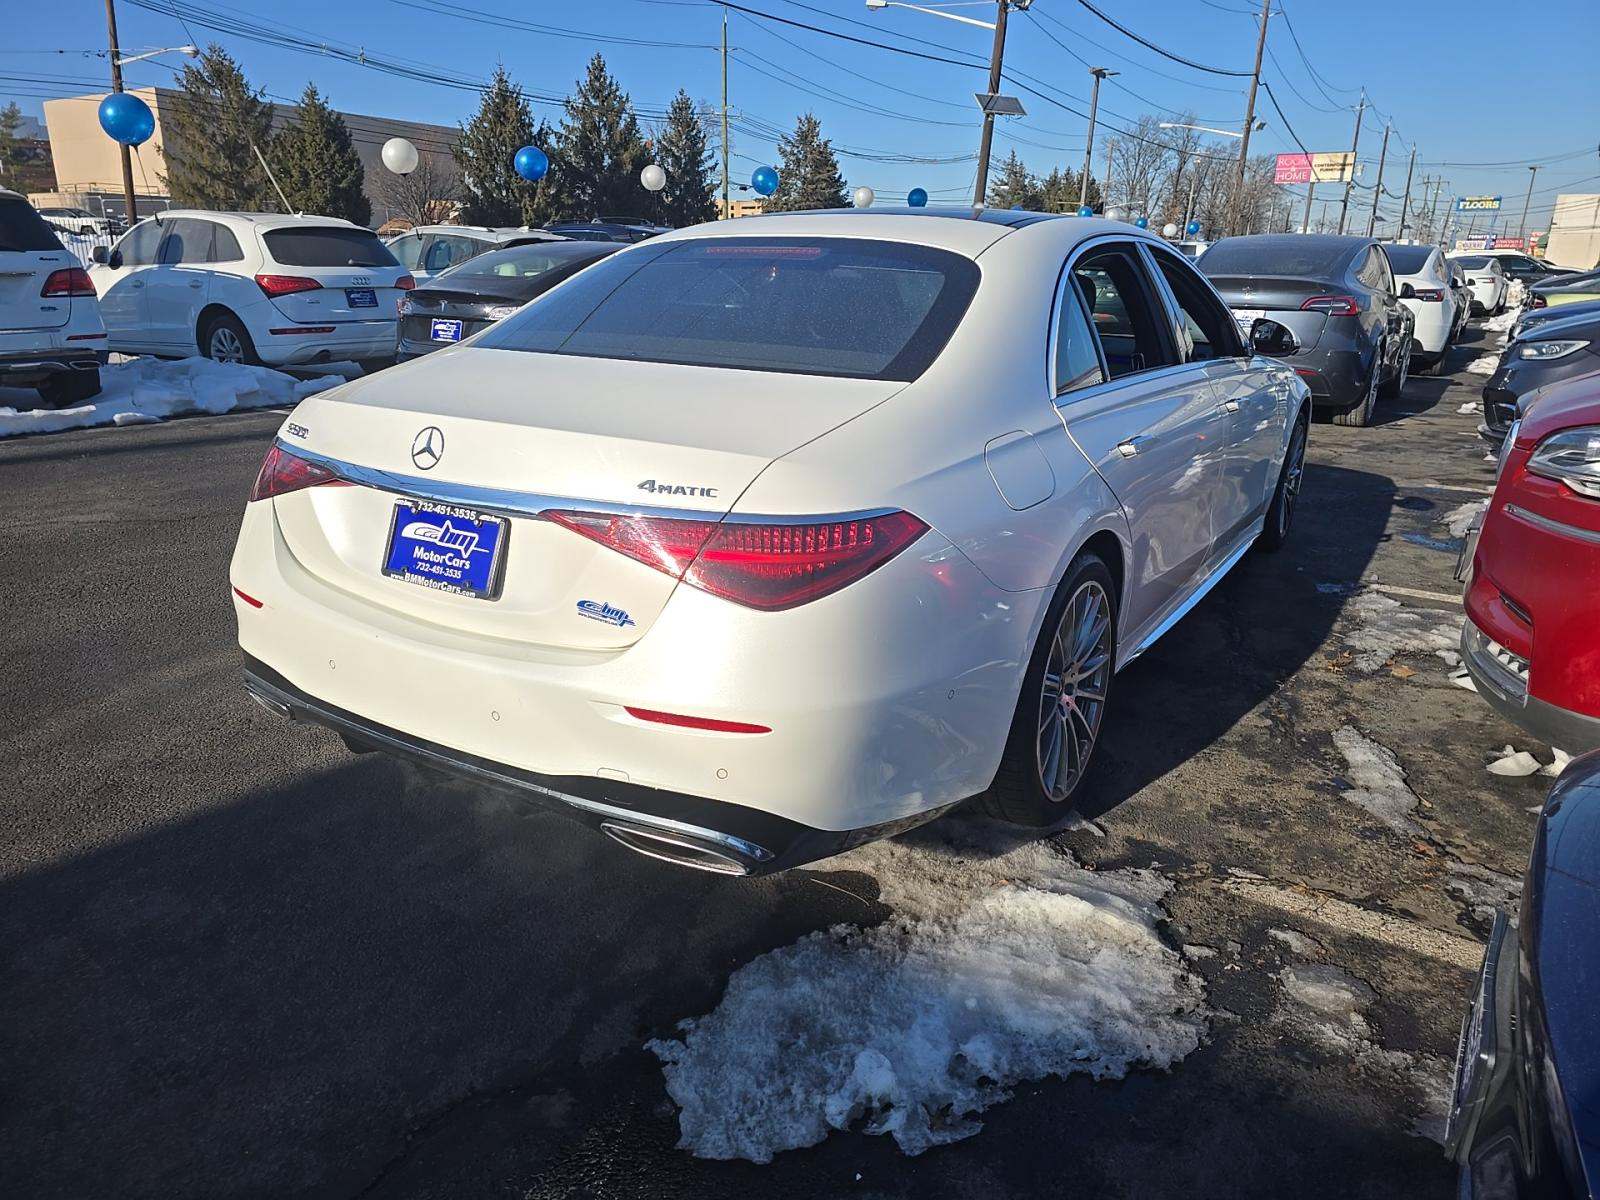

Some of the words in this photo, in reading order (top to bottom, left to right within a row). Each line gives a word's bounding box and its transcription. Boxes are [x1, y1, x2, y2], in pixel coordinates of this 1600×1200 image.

[1276, 171, 1308, 181] HOME
[1459, 200, 1500, 209] FLOORS
[637, 479, 719, 498] 4MATIC
[417, 501, 477, 520] 732-451-3535
[412, 545, 471, 570] MotorCars
[415, 561, 462, 579] 732-451-3535
[390, 572, 476, 598] www.BMMotorCars.com
